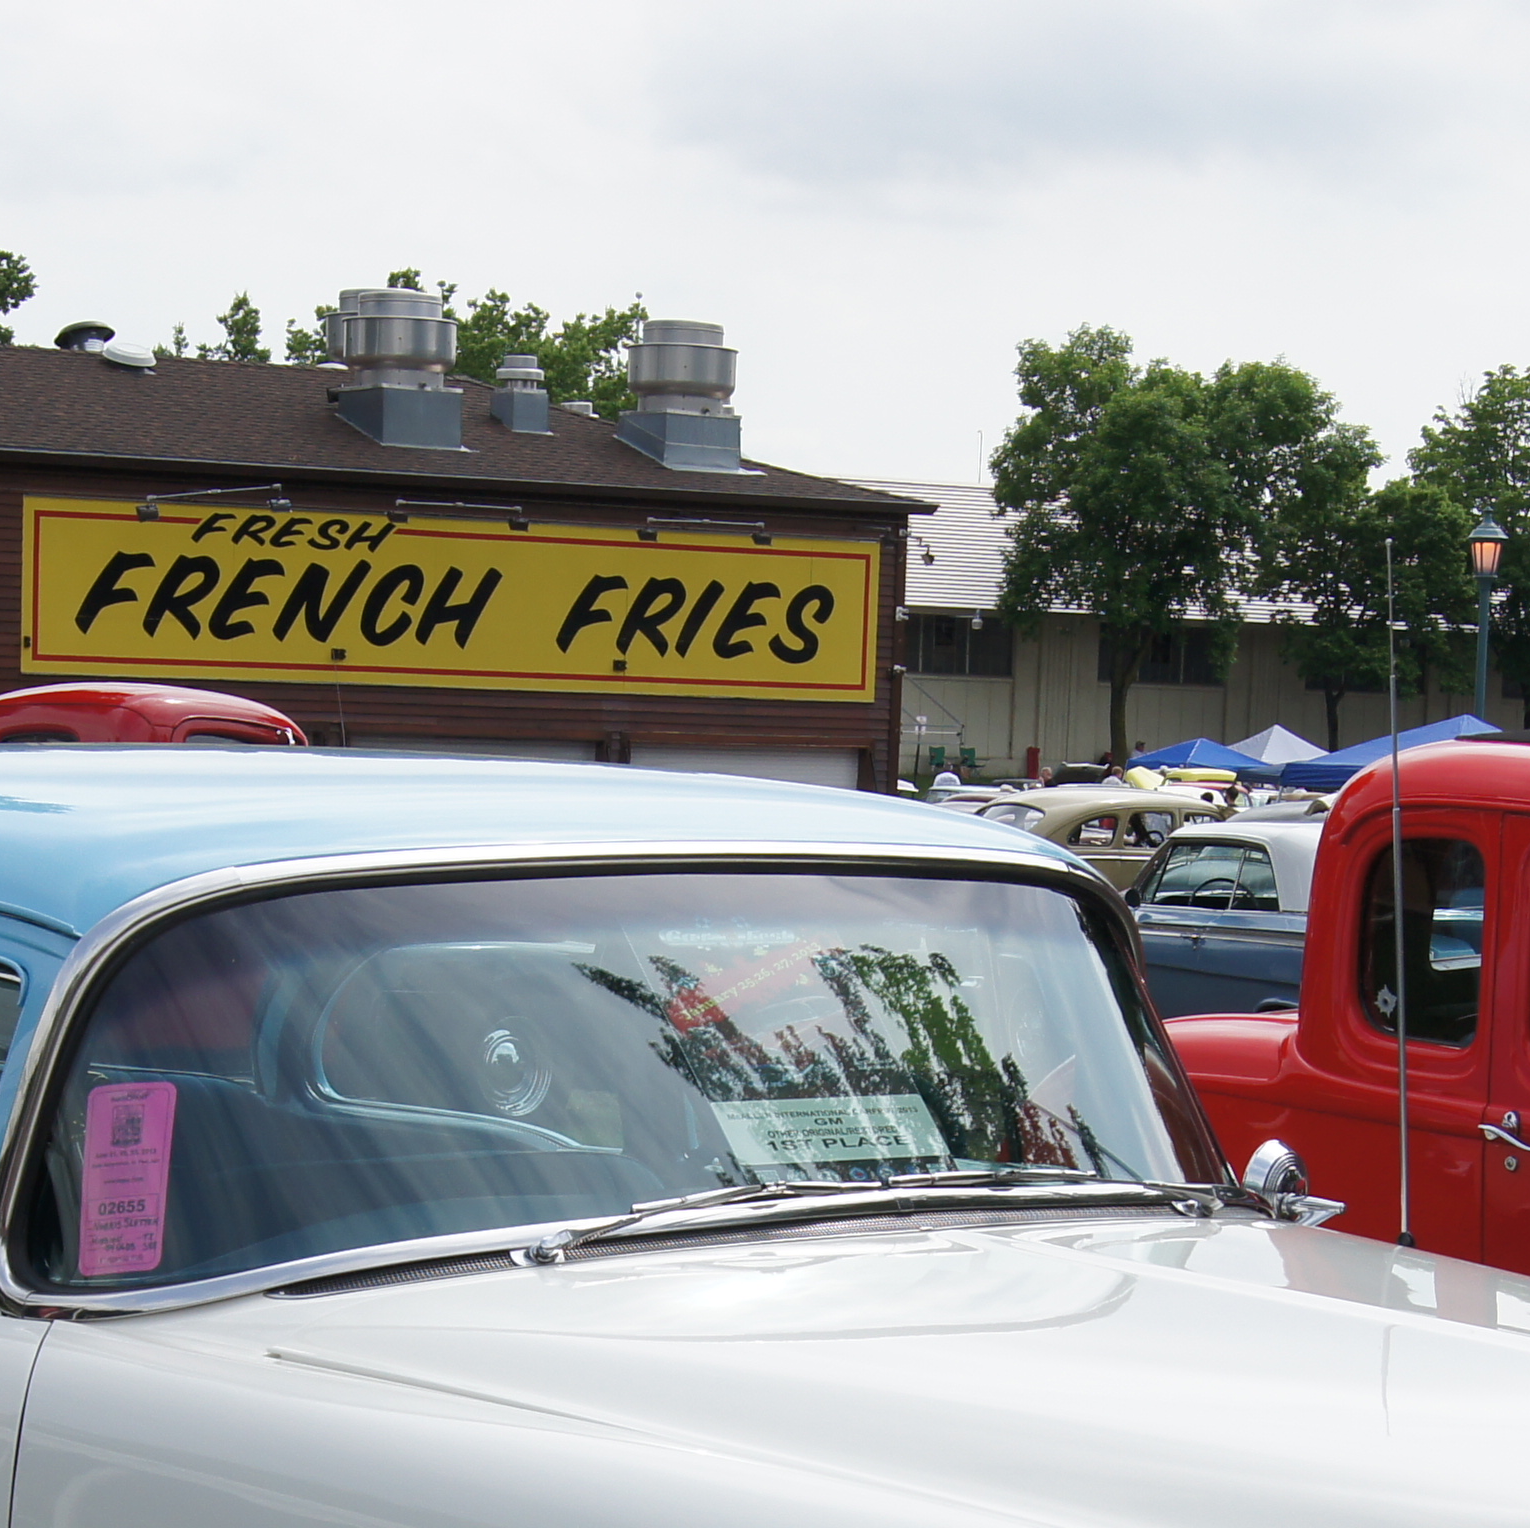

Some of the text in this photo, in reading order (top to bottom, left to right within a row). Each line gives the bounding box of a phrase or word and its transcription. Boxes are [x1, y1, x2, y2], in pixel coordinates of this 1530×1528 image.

[191, 513, 397, 553] FRESH
[74, 551, 835, 664] FRENCH FRIES
[814, 1117, 844, 1126] GM
[766, 1134, 910, 1152] 1ST PLACE
[98, 1199, 146, 1216] 02655
